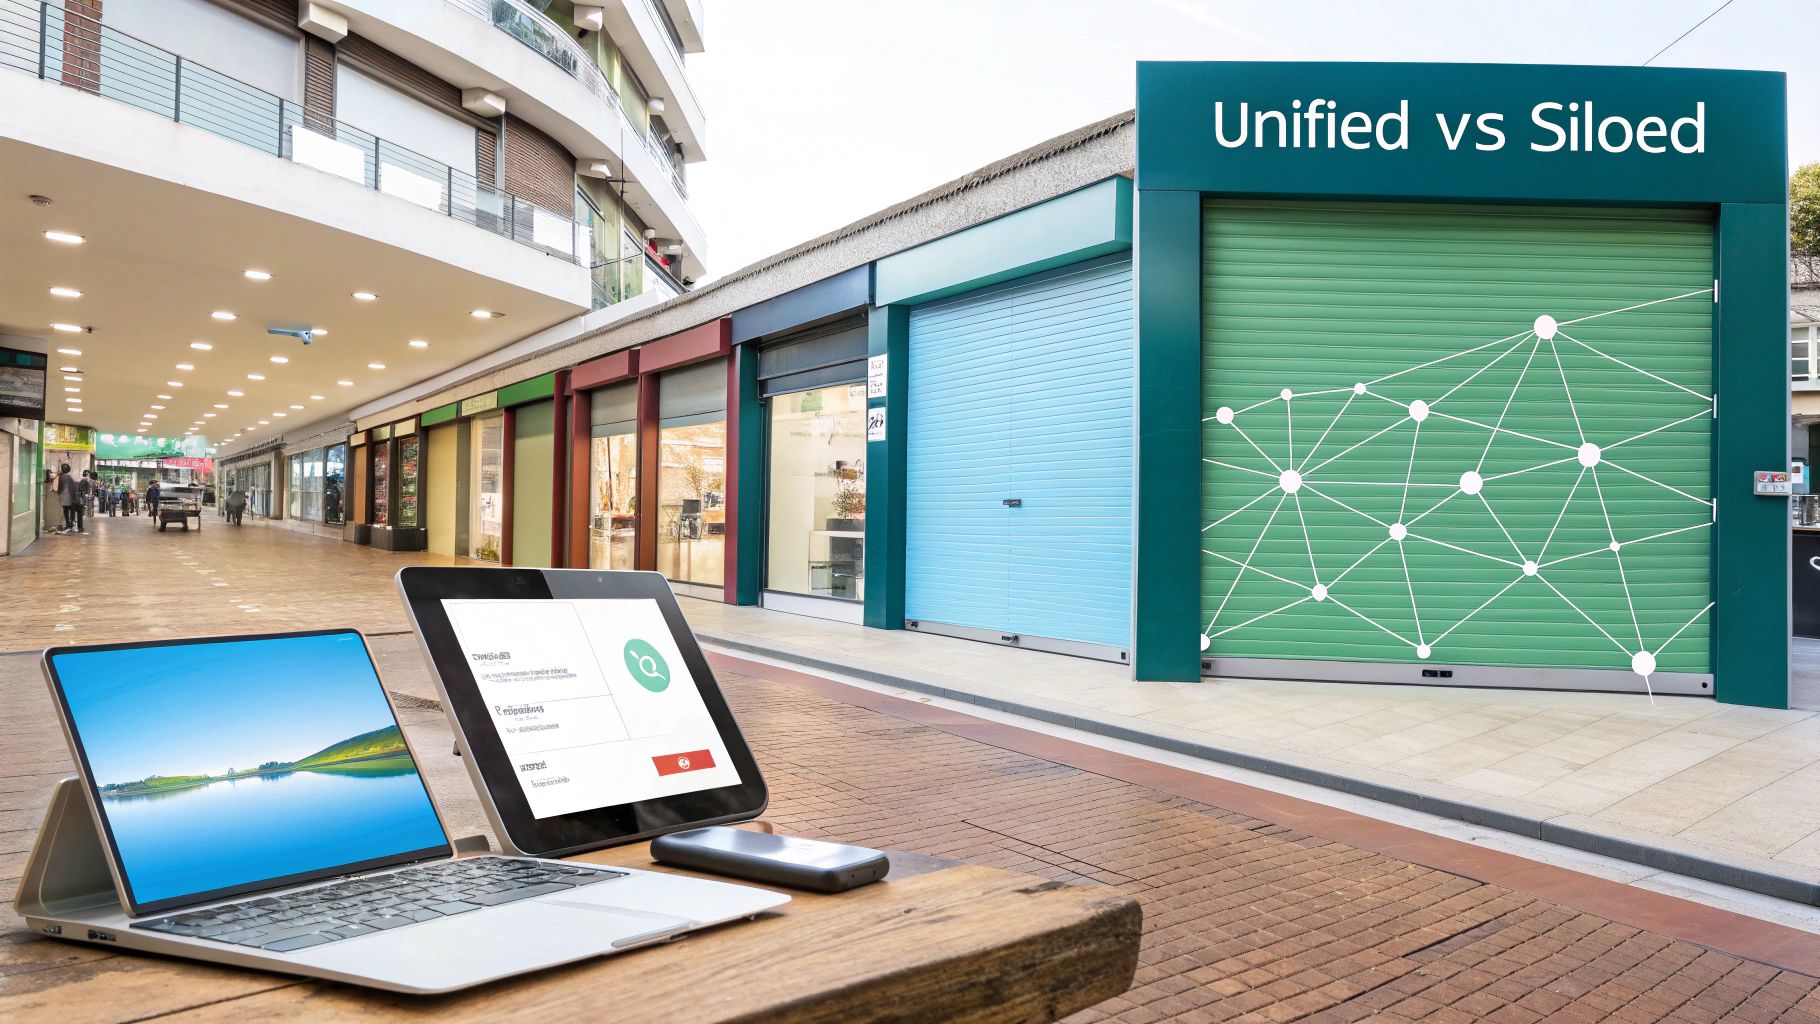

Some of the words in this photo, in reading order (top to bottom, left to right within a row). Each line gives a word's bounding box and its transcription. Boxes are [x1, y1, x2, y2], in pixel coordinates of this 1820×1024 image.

[1215, 98, 1409, 151] Unified
[1435, 112, 1506, 151] vs
[1530, 100, 1705, 154] Siloed
